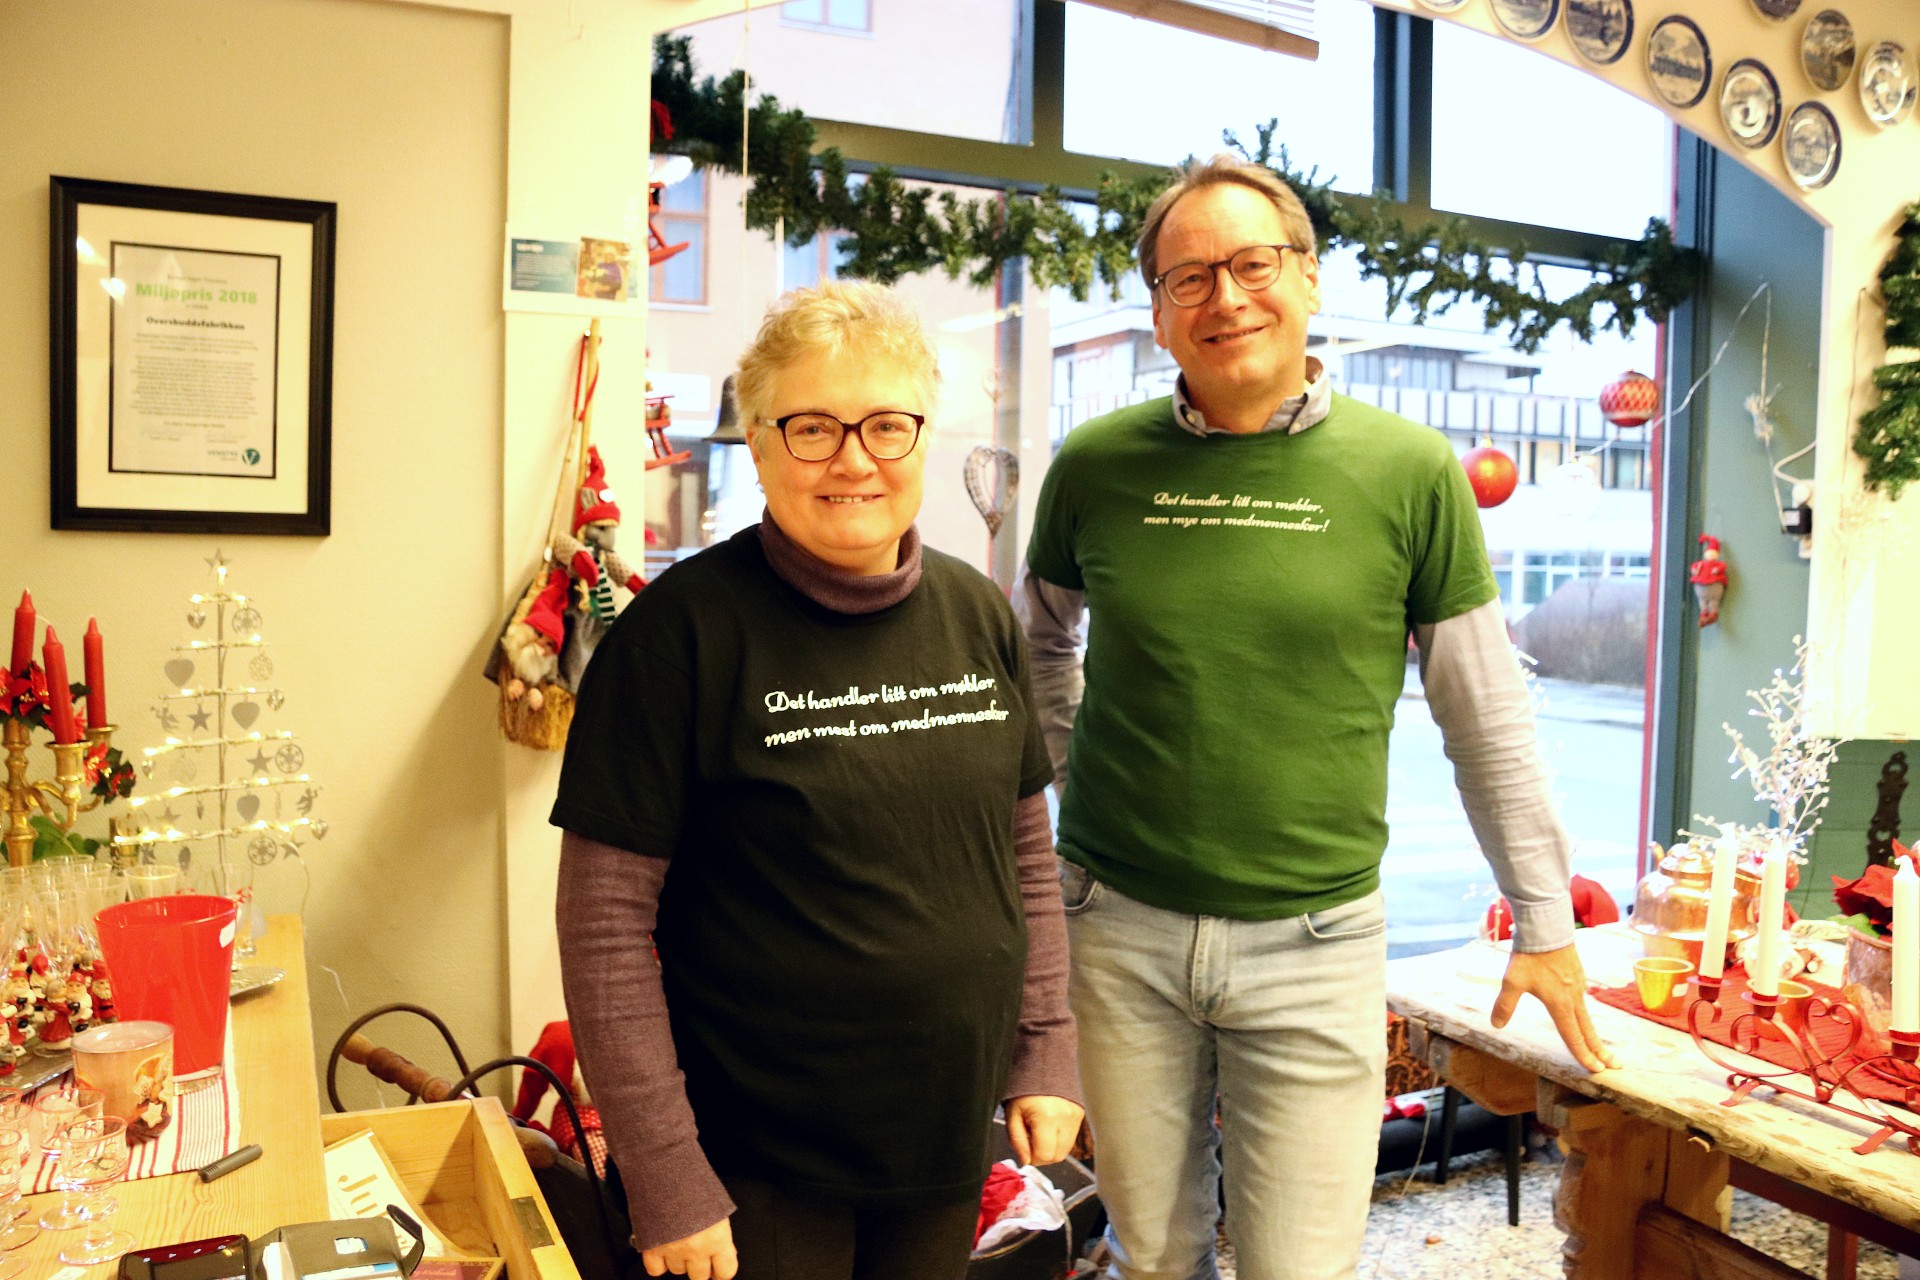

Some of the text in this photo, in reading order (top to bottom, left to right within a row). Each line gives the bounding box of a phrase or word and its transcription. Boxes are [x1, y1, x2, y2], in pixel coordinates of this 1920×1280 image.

[219, 289, 257, 305] 2018
[1154, 492, 1179, 505] Det
[1179, 493, 1230, 507] handler
[1232, 493, 1251, 508] litt
[1252, 500, 1272, 509] om
[1143, 513, 1330, 533] men mye om medmennesker!
[764, 691, 805, 713] Det
[807, 686, 880, 710] handler
[882, 684, 907, 704] litt
[909, 686, 937, 700] om
[764, 728, 811, 748] men
[812, 719, 857, 738] mest
[859, 721, 889, 737] om
